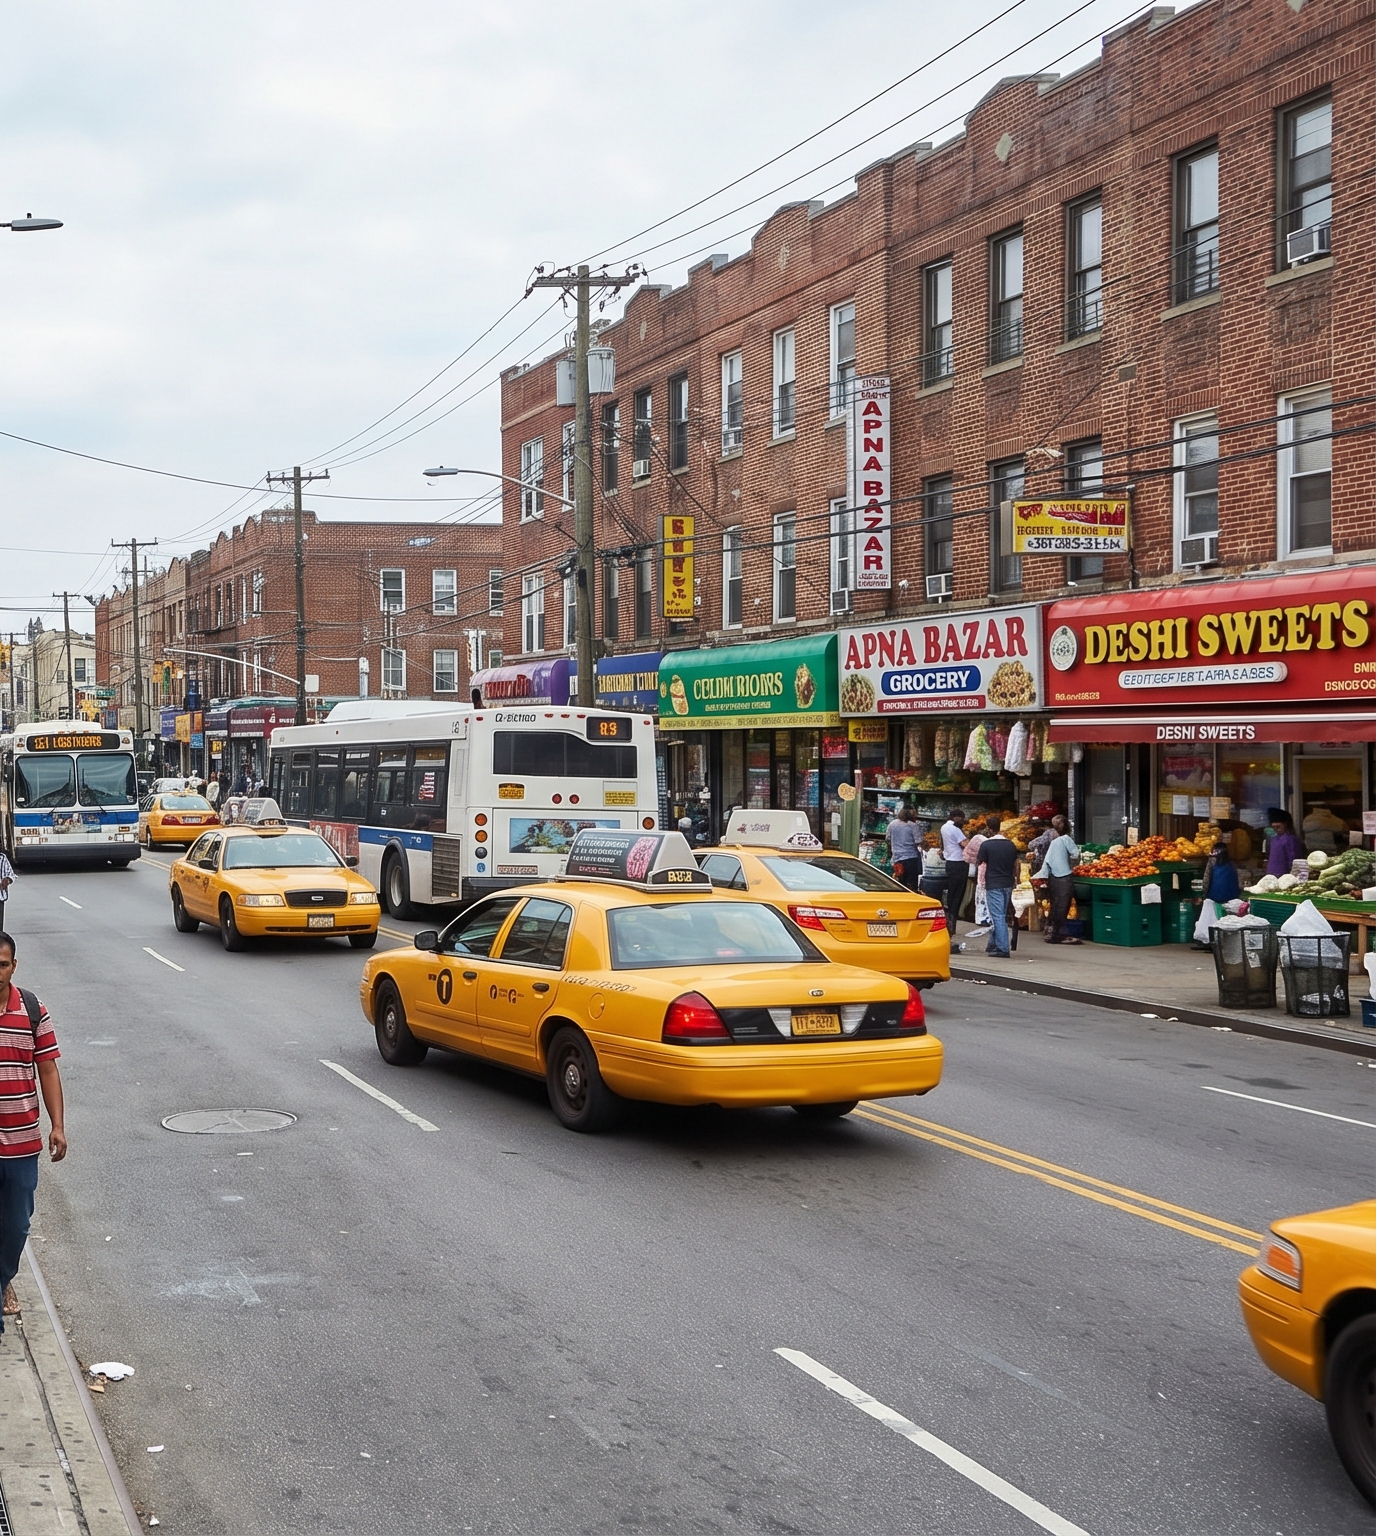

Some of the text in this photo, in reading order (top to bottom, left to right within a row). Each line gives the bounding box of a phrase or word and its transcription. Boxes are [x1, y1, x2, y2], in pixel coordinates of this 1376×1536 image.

[862, 401, 884, 471] APNA
[864, 481, 884, 570] BAZAR
[844, 616, 1029, 670] APNA BAZAR
[1084, 599, 1369, 664] DESHI SWEETS
[889, 669, 971, 693] GROCERY
[1198, 725, 1255, 740] SWEETS
